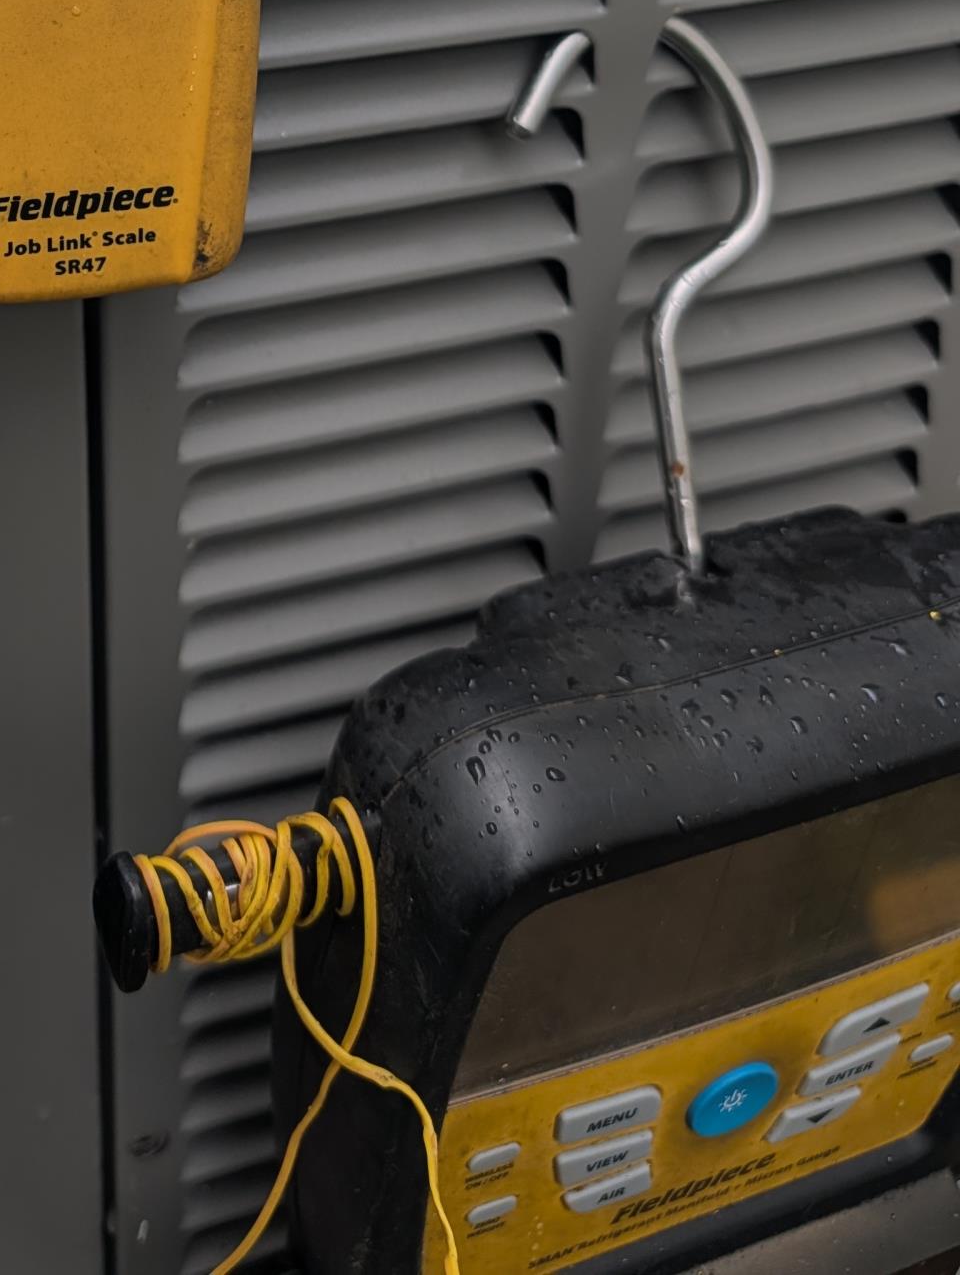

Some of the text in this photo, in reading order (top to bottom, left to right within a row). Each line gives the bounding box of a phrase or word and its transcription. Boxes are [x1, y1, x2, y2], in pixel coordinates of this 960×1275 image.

[4, 228, 157, 257] Job Link Scale
[55, 256, 107, 276] SR47
[825, 1060, 875, 1086] ENTER
[586, 1107, 639, 1134] MENU
[586, 1150, 629, 1173] VIEW
[597, 1186, 627, 1205] AIR
